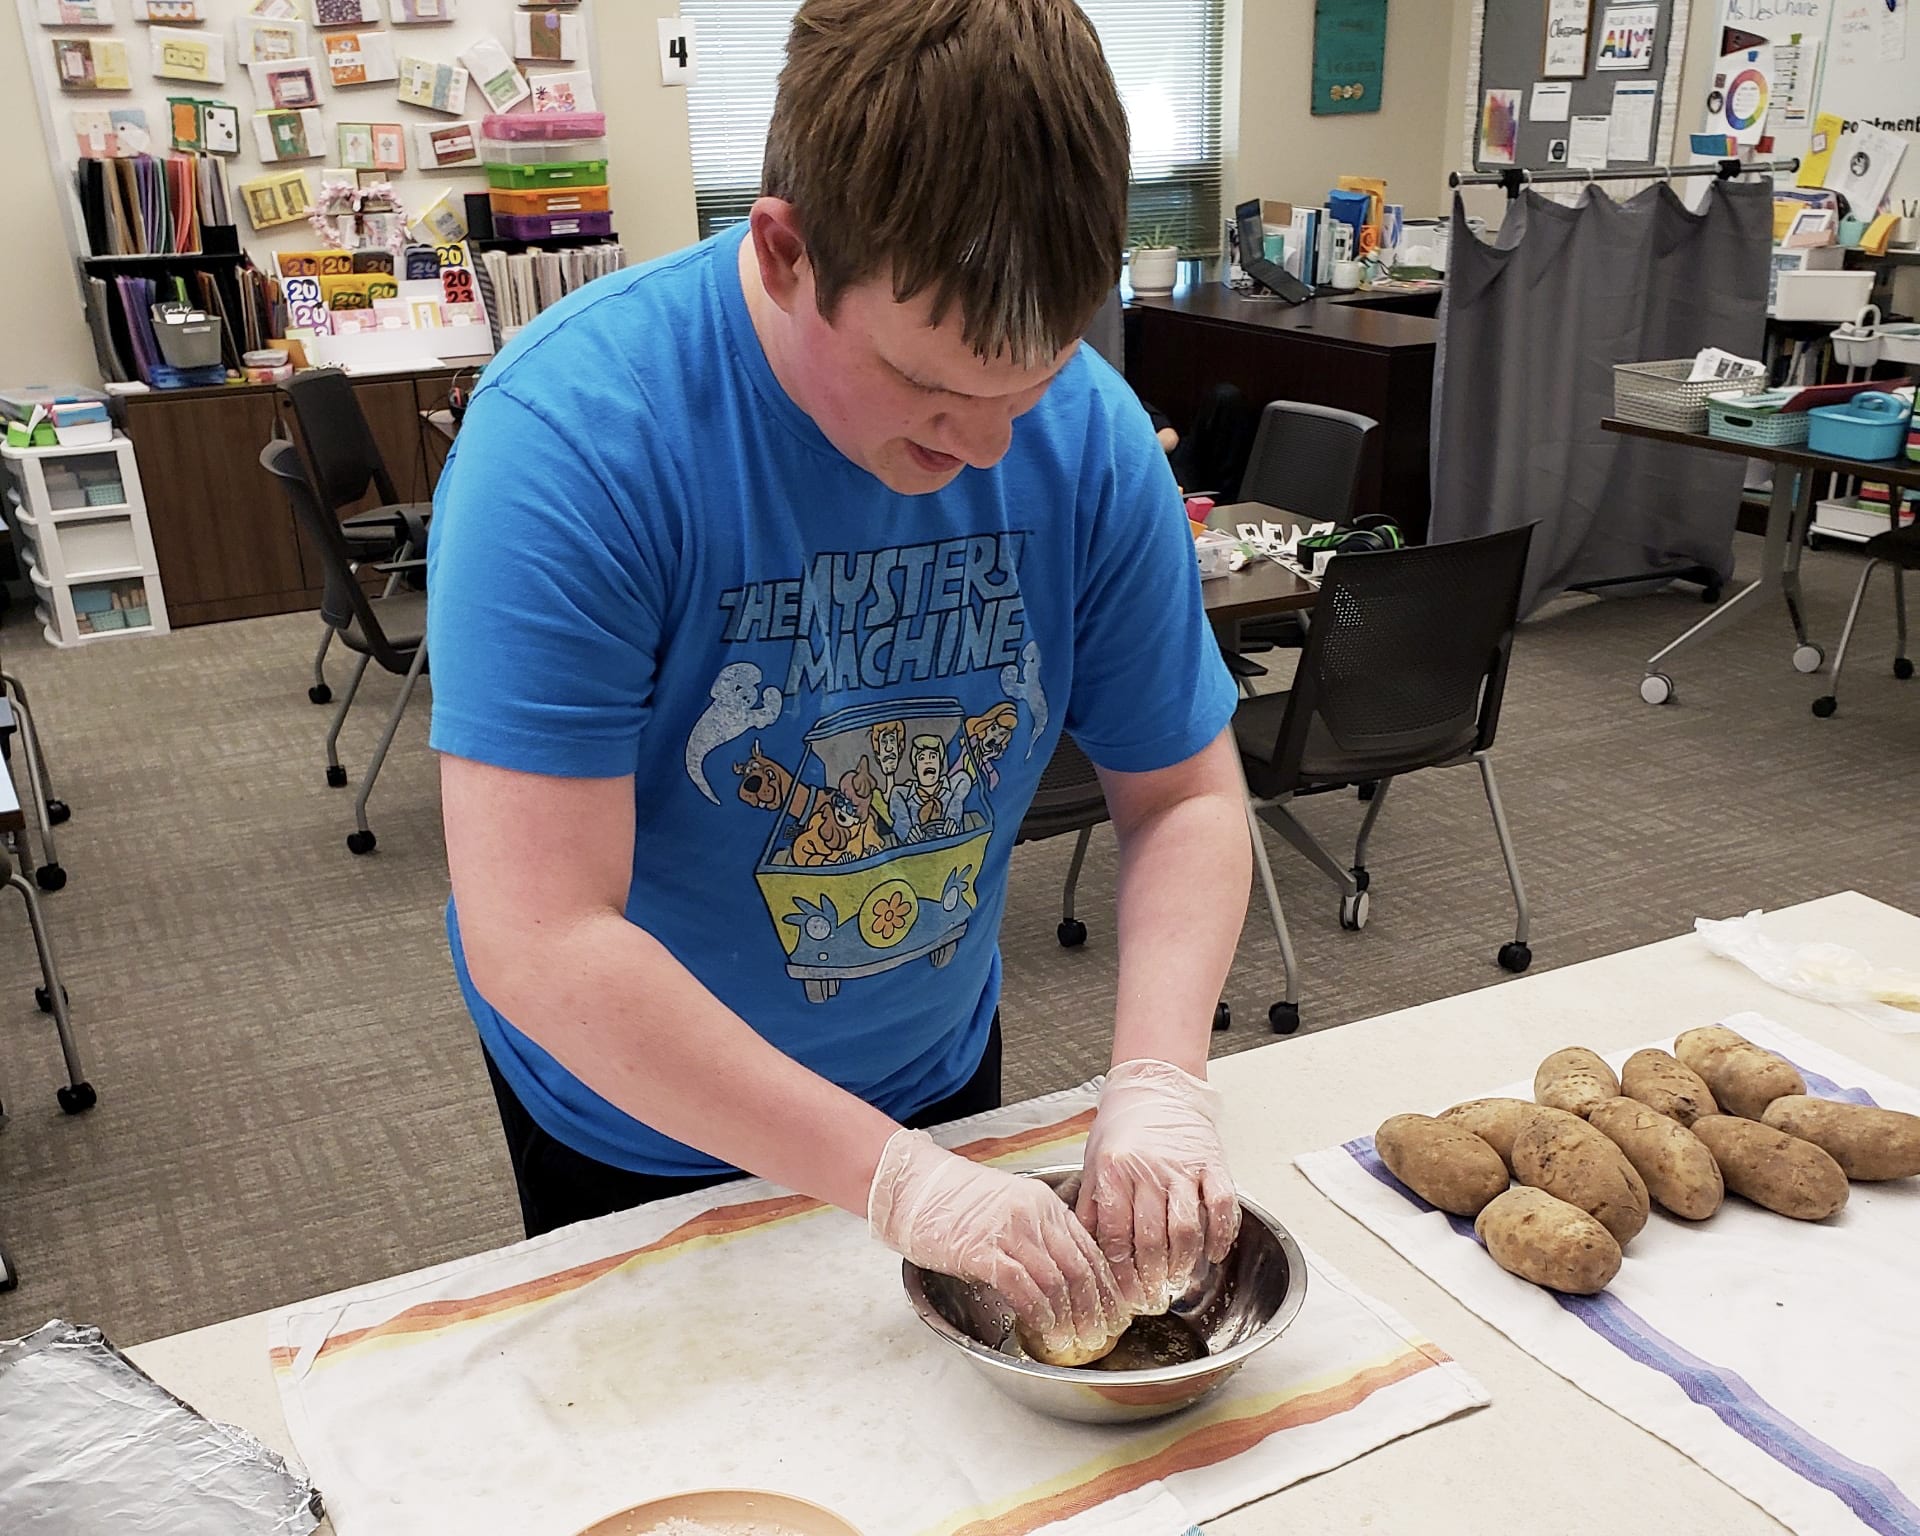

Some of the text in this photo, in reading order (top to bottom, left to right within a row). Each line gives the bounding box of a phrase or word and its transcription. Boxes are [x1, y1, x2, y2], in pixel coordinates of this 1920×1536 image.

[669, 36, 688, 68] 4
[445, 270, 471, 288] 20
[719, 531, 1034, 642] THE MYSTERY
[784, 596, 1025, 697] MACHINE
